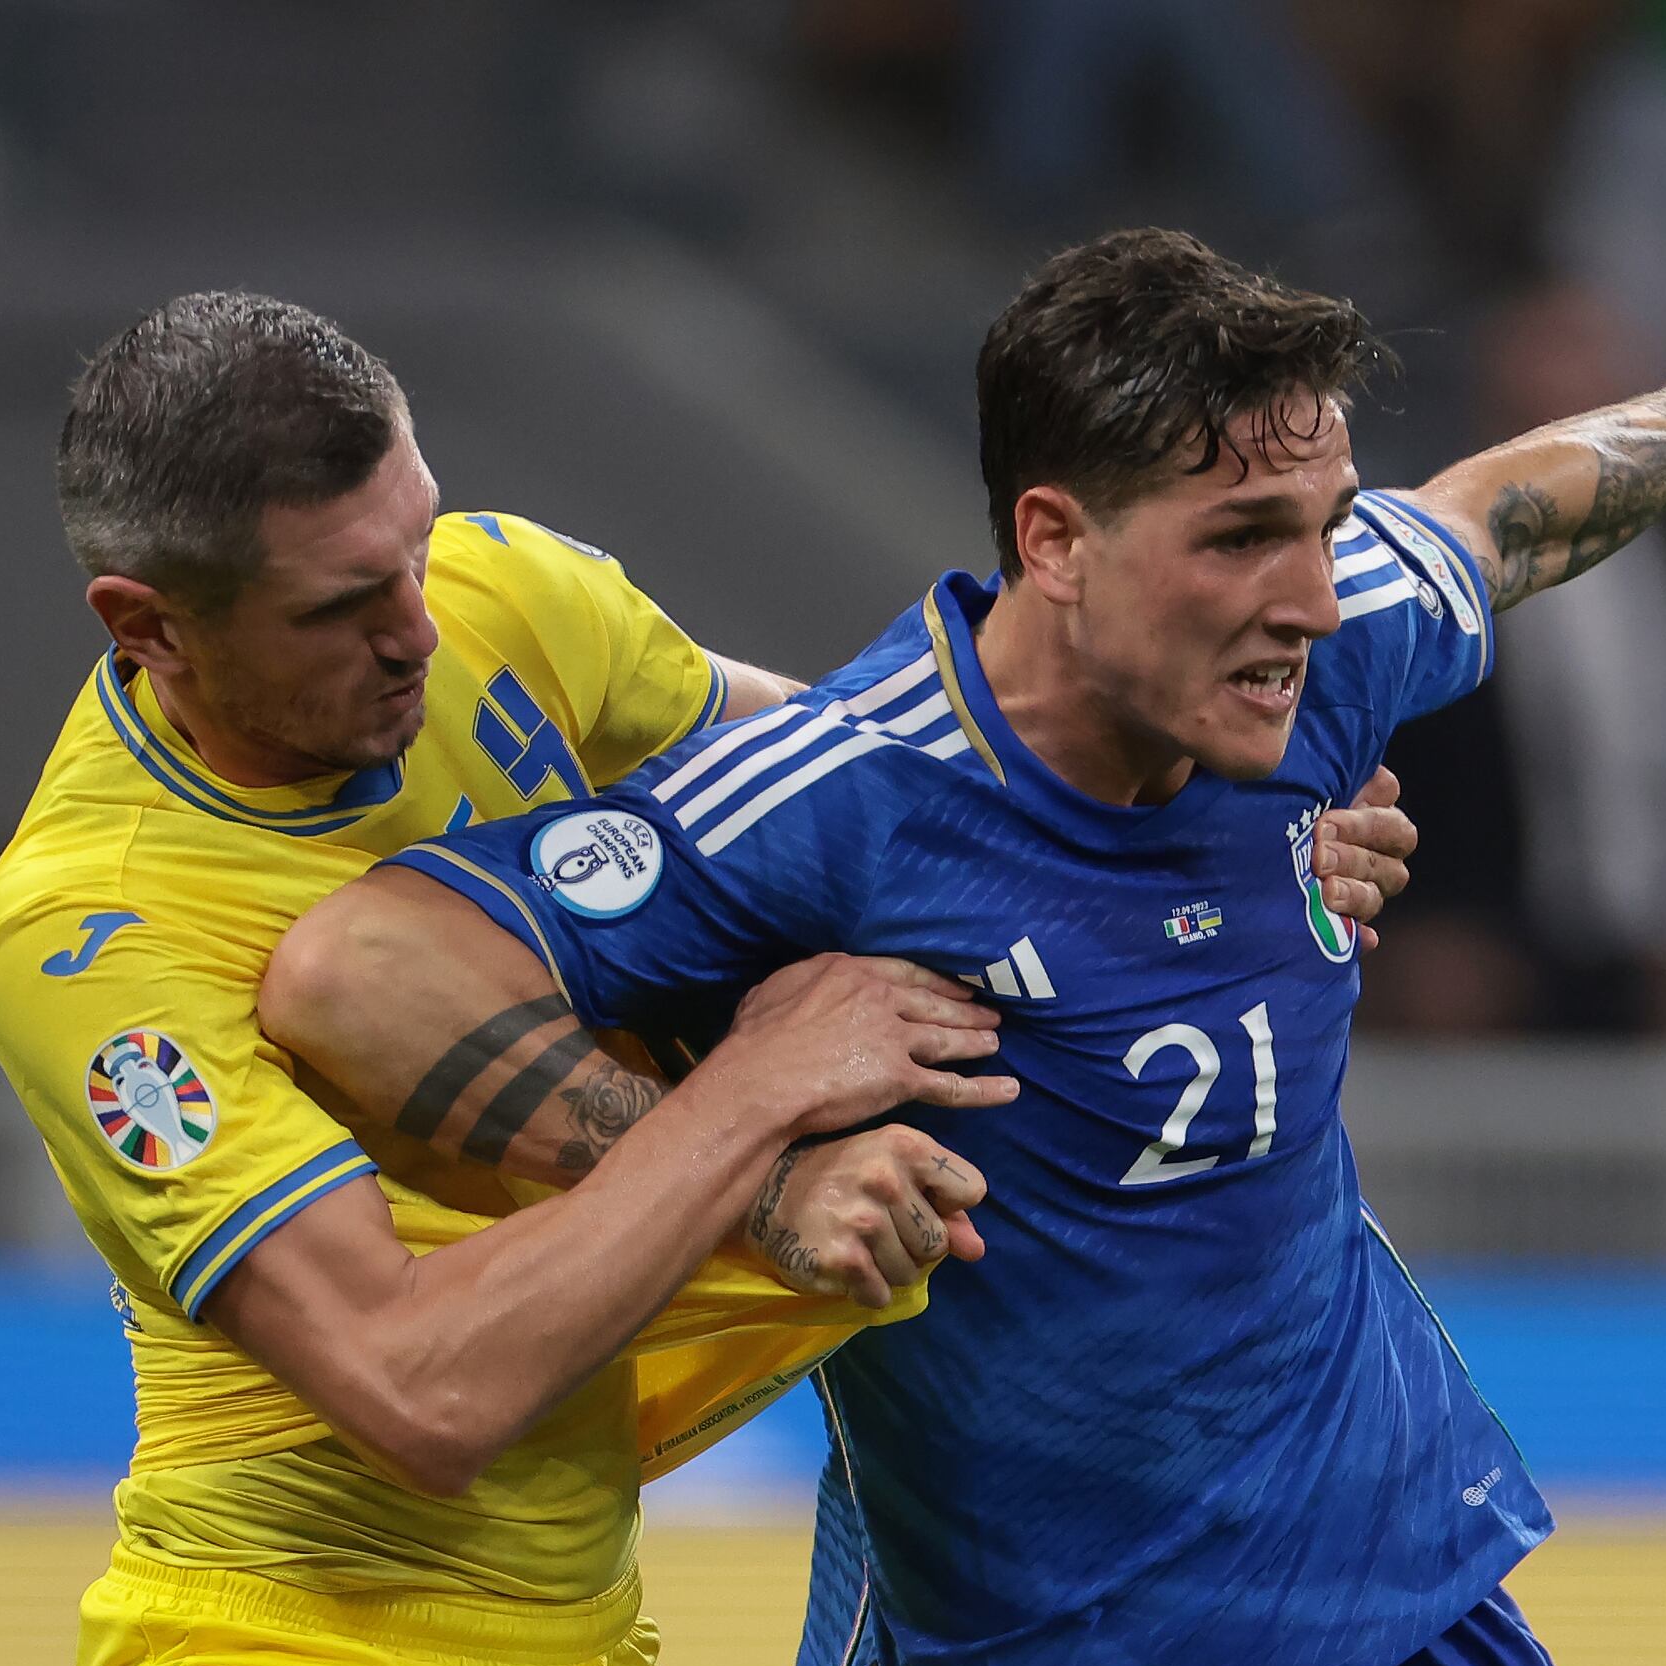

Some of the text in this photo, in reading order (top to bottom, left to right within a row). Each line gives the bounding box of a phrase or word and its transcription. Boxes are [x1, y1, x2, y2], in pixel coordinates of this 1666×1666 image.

[586, 824, 635, 879] CHAMPIONS
[597, 818, 647, 873] EUROPEAN
[623, 819, 650, 848] UEFA
[1171, 900, 1209, 917] 12.09.2023
[1118, 1001, 1278, 1186] 21
[697, 1402, 741, 1436] ASSOCIATION
[744, 1384, 779, 1407] FOOTBALL
